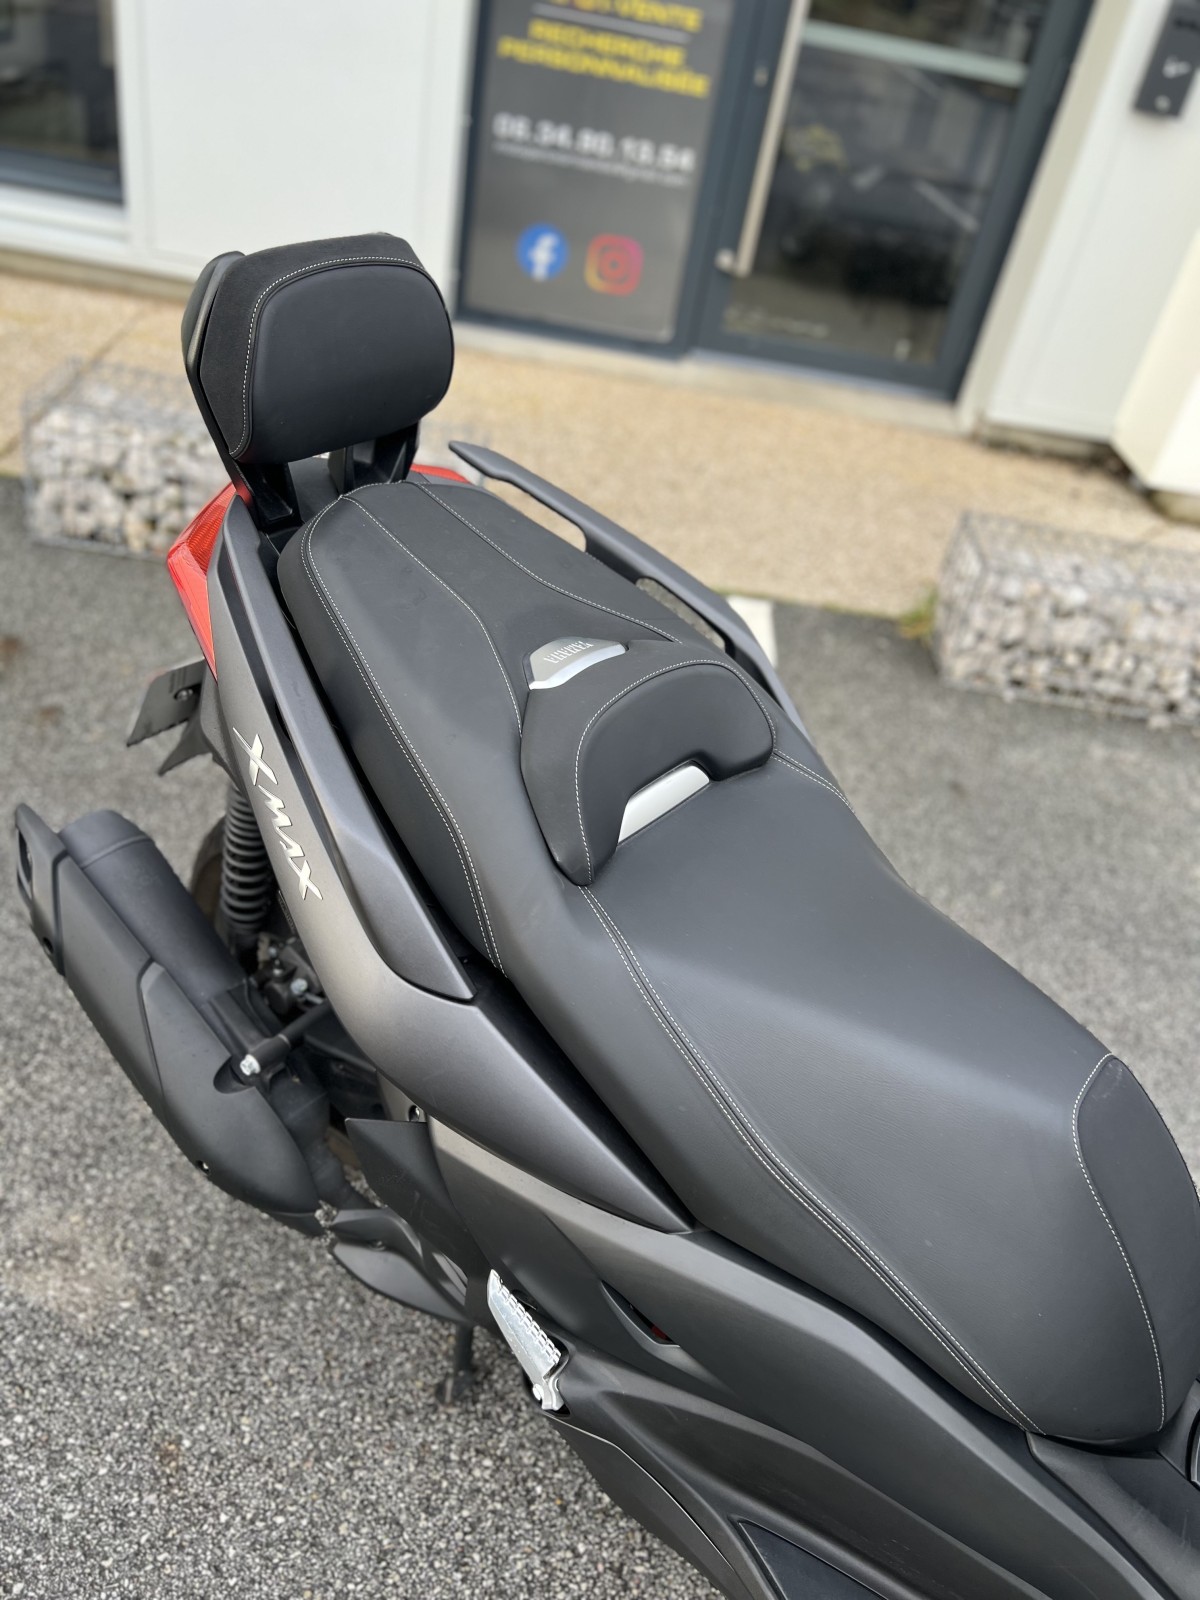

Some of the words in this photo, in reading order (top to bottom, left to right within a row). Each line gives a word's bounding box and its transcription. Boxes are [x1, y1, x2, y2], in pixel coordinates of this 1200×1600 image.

[528, 19, 685, 67] RECHERCHE
[543, 640, 595, 664] YAMAHA
[232, 726, 323, 901] XMAX
